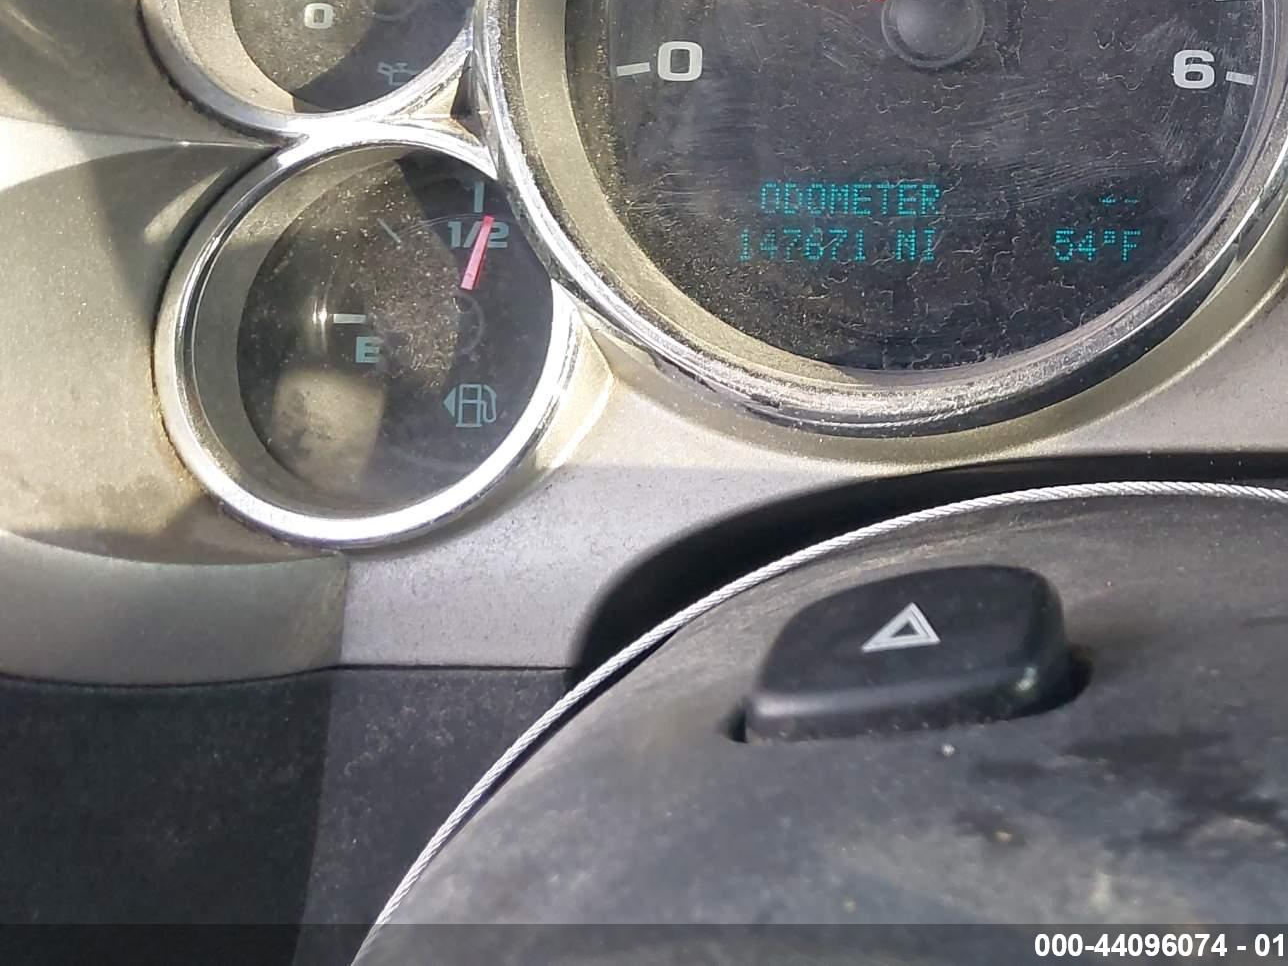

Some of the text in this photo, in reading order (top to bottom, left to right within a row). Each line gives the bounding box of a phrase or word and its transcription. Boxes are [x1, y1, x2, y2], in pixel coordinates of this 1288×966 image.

[304, 3, 334, 29] 0
[657, 42, 702, 81] 0
[1173, 49, 1215, 88] 6
[759, 182, 941, 215] ODOMETER
[447, 221, 510, 248] 1/2
[739, 228, 867, 261] 147671
[356, 337, 381, 363] E
